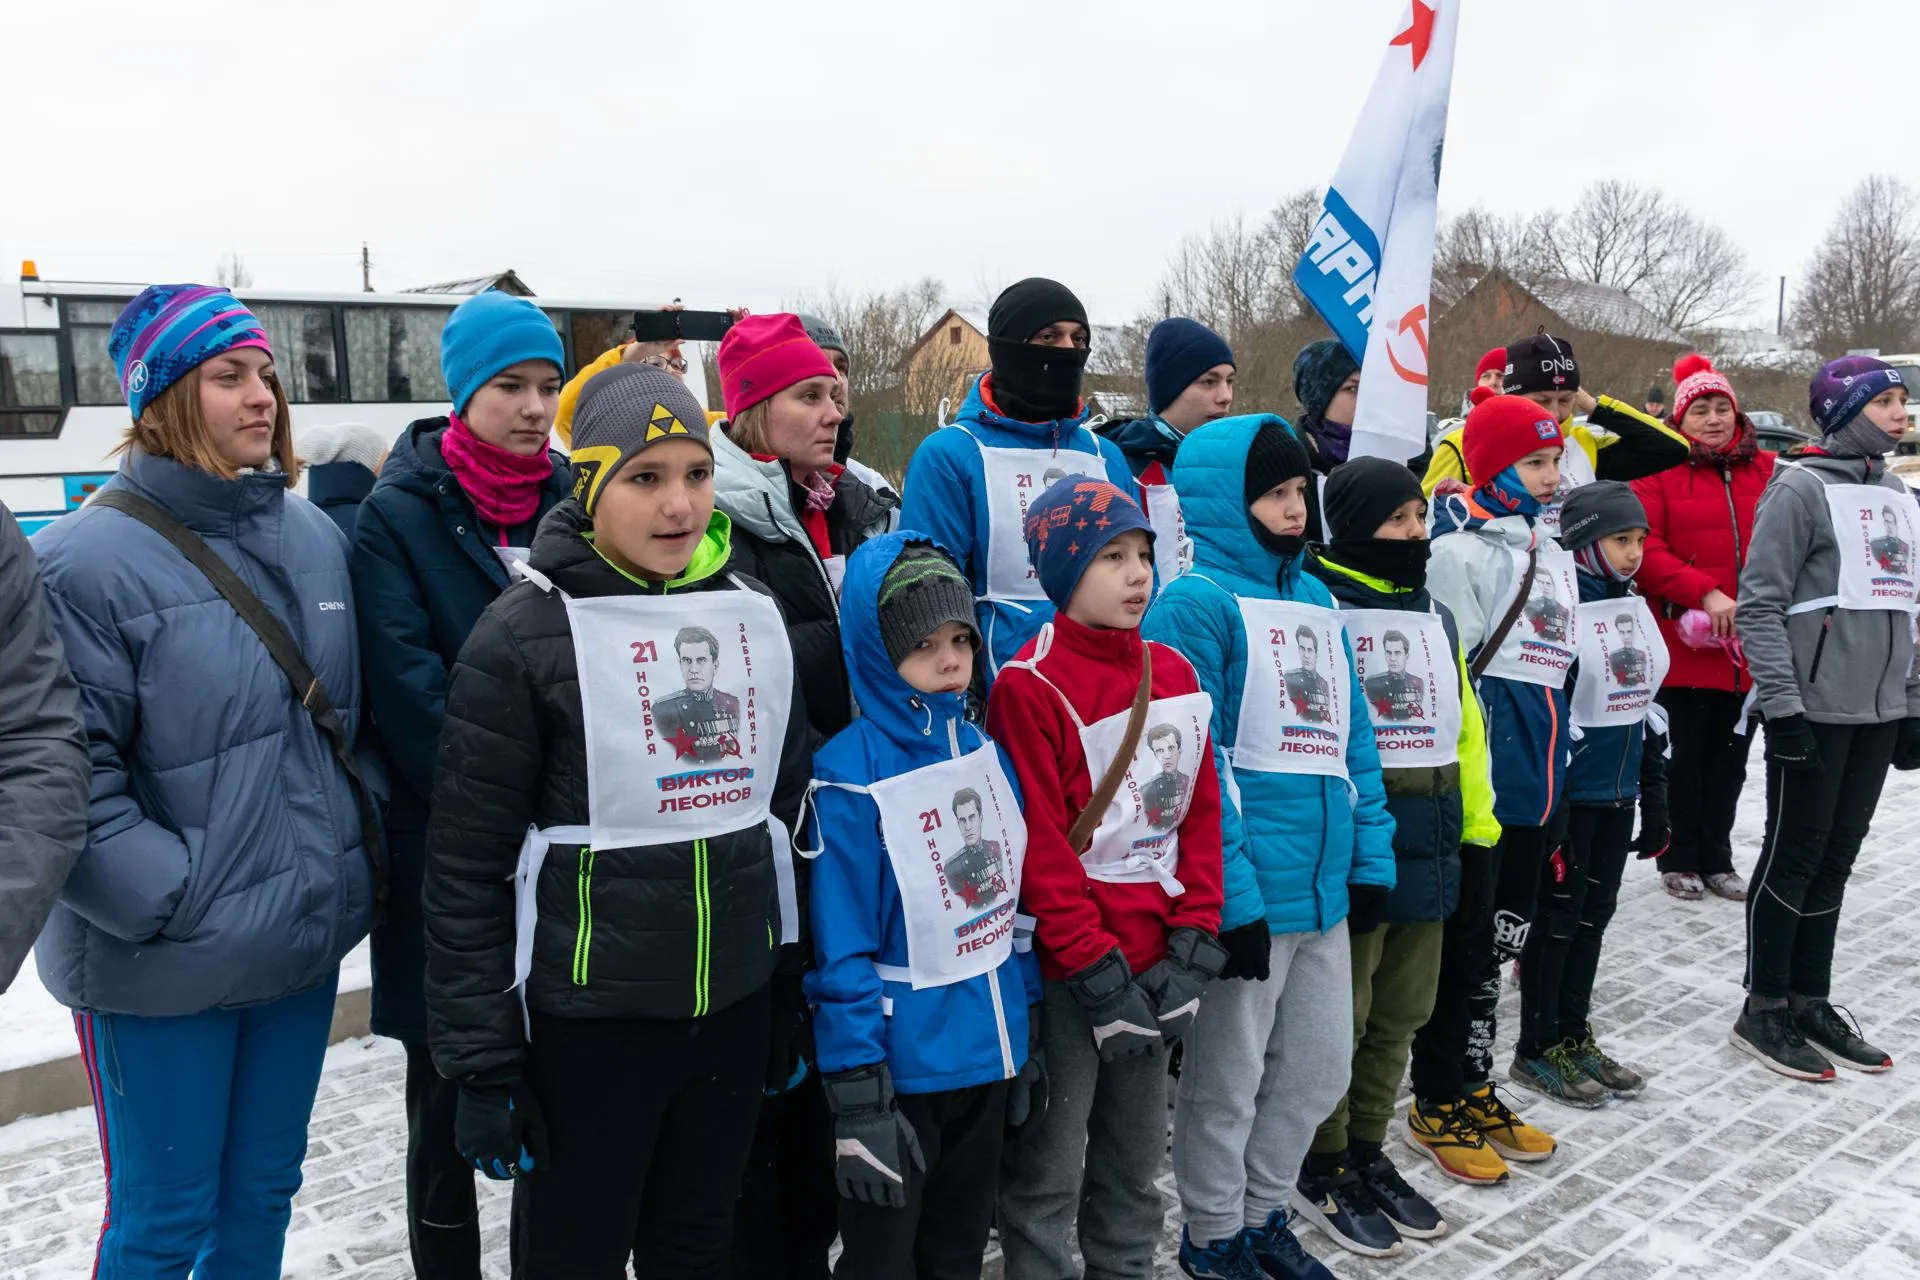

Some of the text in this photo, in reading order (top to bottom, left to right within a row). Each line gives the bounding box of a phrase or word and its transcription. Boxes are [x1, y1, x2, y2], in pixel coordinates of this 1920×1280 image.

[1541, 355, 1575, 375] DNB
[1016, 474, 1033, 488] 21
[1860, 509, 1873, 521] 21
[1872, 577, 1914, 588] ВИКТОР
[1870, 588, 1913, 599] ЛЕОНОВ
[1269, 628, 1286, 646] 21
[1593, 622, 1609, 635] 21
[629, 640, 659, 664] 21
[1356, 636, 1373, 652] 21
[1522, 641, 1574, 659] ВИКТОР
[738, 622, 757, 754] ЗАБЕГ ПАМЯТИ
[1273, 650, 1286, 709] НОЯБРЯ
[1428, 671, 1437, 718] ПАМЯТИ
[636, 671, 656, 756] НОЯБРЯ
[1605, 700, 1649, 712] ЛЕОНОВ
[1283, 726, 1338, 743] ВИКТОР
[1278, 741, 1339, 757] ЛЕОНОВ
[1376, 738, 1435, 750] ЕОНОВ
[661, 767, 752, 792] ВИКТОР
[657, 786, 751, 813] ЛЕОНОВ
[918, 808, 943, 833] 21
[927, 838, 952, 911] НОЯБРЯ
[957, 898, 1015, 938] ВИКТОР
